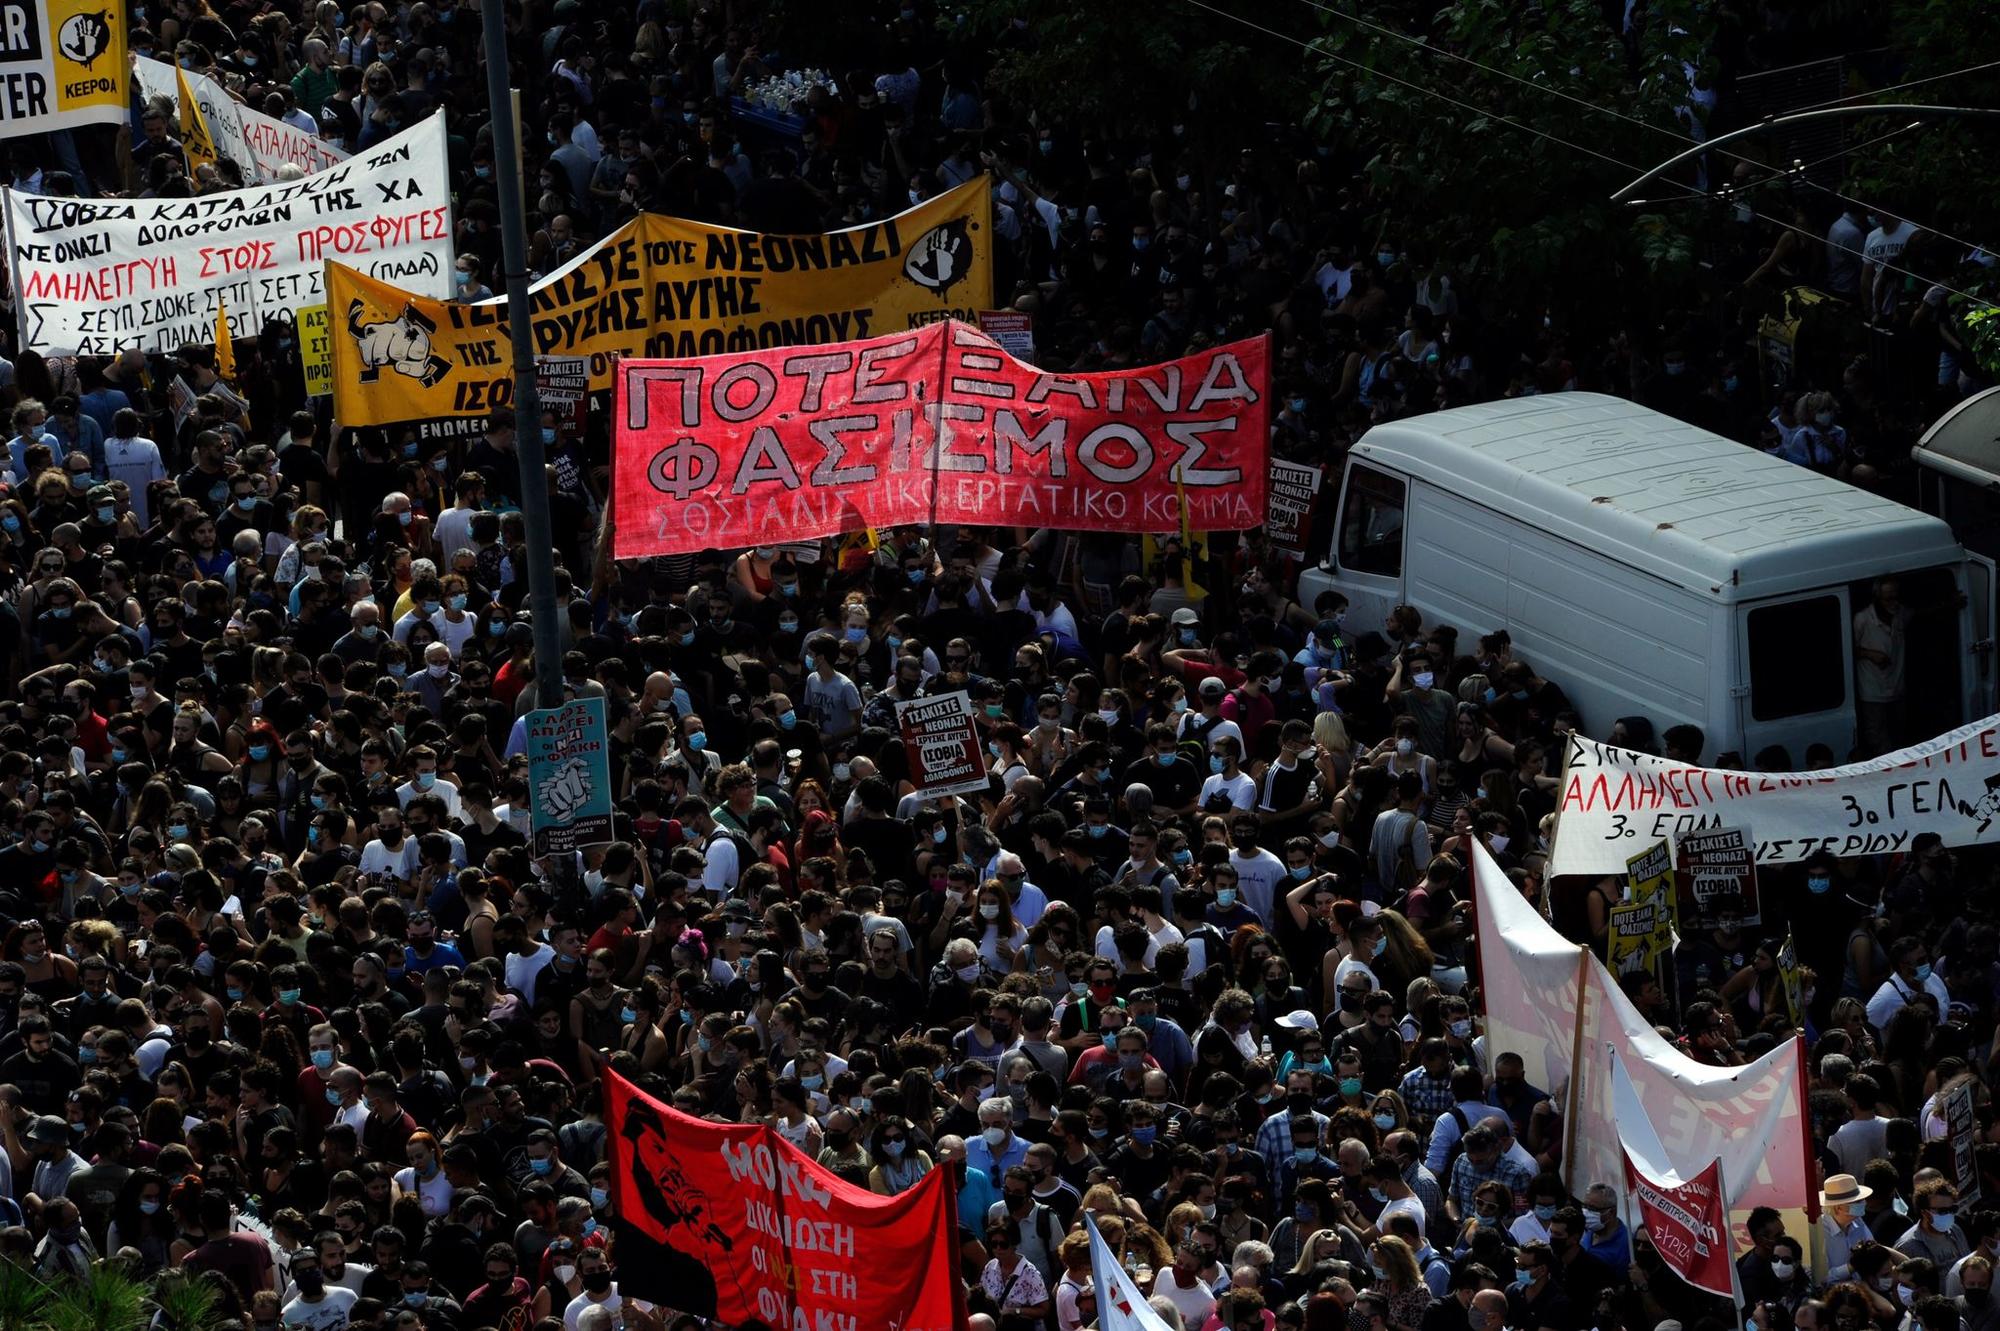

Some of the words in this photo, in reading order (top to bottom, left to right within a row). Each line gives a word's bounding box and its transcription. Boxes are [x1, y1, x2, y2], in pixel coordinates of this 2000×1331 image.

[25, 199, 136, 234] ΙΣΟΒΙΑ
[367, 143, 411, 172] ΤΩΝ
[17, 232, 112, 264] ΝΕΟΝΑΖΙ
[138, 203, 292, 247] ΔΟΛΟΦΟΝΩΝ
[309, 188, 362, 215] ΤΗΣ
[376, 178, 423, 203] ΧΑ
[199, 240, 279, 279] ΣΤΟΥΣ
[297, 206, 448, 262] ΠΡΟΣΦΥΓΕΣ
[644, 240, 697, 268] ΤΟΥΣ
[706, 221, 902, 272] ΝΕΟΝΑΖΙ
[455, 340, 502, 368] ΤΗΣ
[654, 277, 762, 323] ΑΥΓΗΣ
[626, 337, 919, 430] ΠΟΤΕ
[950, 328, 1259, 414] ΞΑΝΑ
[647, 401, 1241, 501] ΦΑΣΙΣΜΟΣ
[957, 477, 1127, 520] ΕΡΓΑΤΙΚΟ
[1143, 489, 1254, 521] ΚΟΜΜΑ
[907, 699, 959, 725] ΤΣΑΚΙΣΤΕ
[924, 715, 967, 734] ΝΕΟΝΑΖΙ
[923, 743, 964, 764] ΙΣΟΒΙΑ
[1685, 832, 1740, 854] ΤΣΑΚΙΣΤΕ
[1702, 850, 1746, 864] ΝΕΟΝΑΖΙ
[1695, 879, 1739, 894] ΙΣΟΒΙΑ
[810, 1268, 857, 1301] ΣΤΗ
